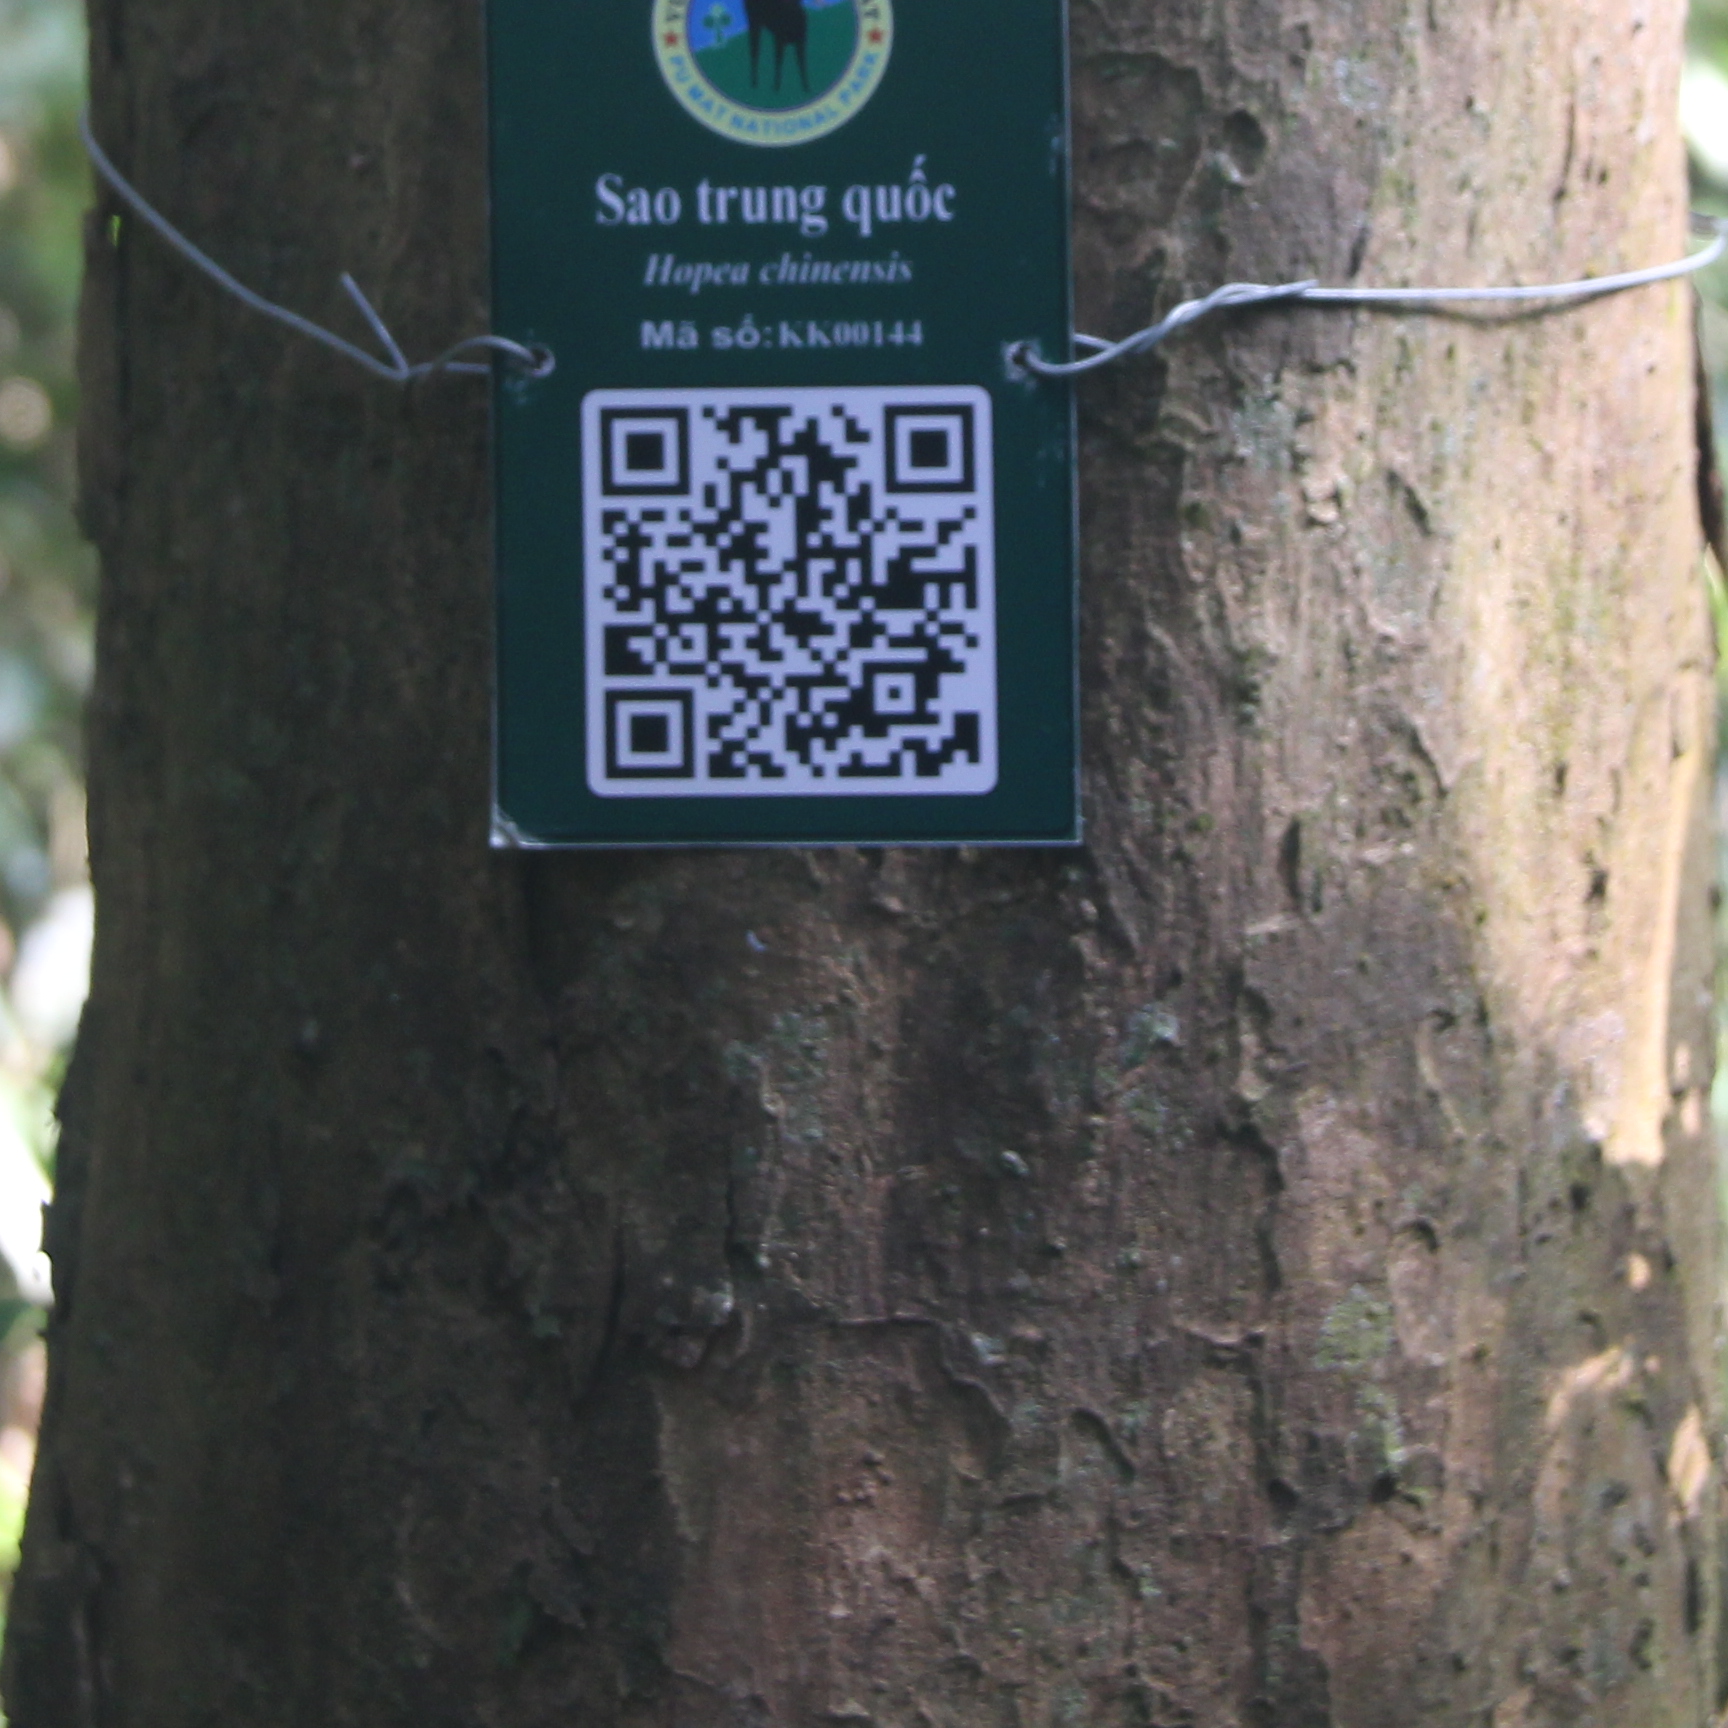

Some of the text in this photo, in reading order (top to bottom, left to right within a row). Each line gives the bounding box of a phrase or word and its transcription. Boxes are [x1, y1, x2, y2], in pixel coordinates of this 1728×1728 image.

[729, 103, 838, 136] NATIONAL
[838, 52, 880, 106] PARK
[595, 153, 957, 239] Sao trung quốc
[643, 250, 914, 296] Hopea chinensis
[639, 320, 700, 350] Mã
